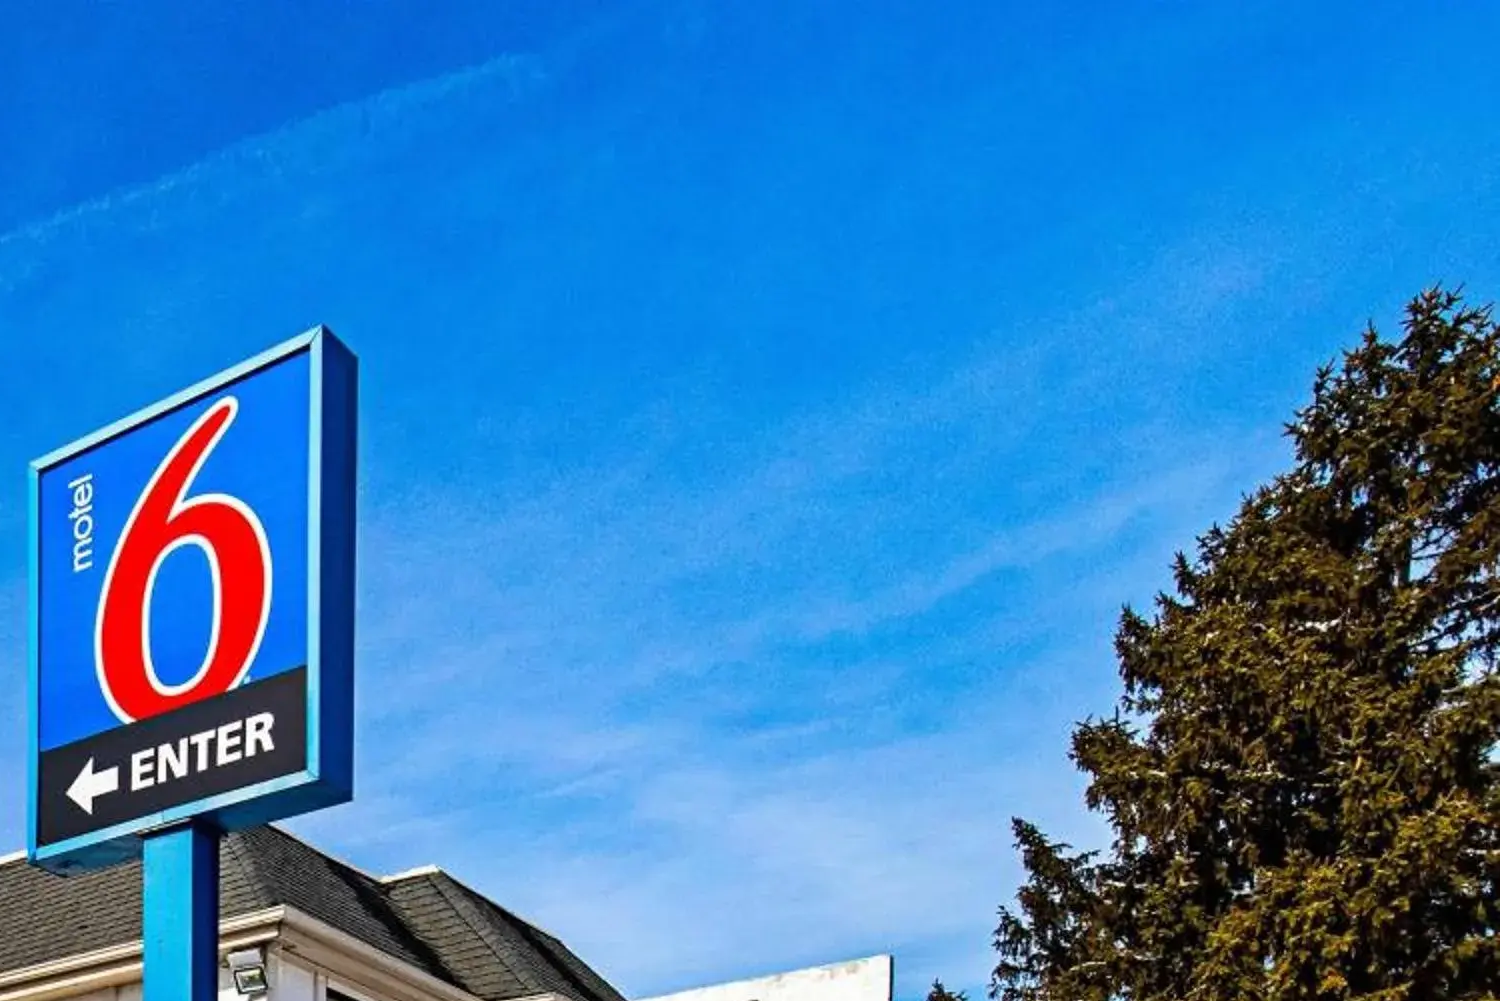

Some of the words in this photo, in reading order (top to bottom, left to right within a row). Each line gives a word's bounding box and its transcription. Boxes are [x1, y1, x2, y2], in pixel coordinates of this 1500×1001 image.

[67, 472, 93, 573] motel
[94, 396, 272, 725] 6
[130, 711, 276, 792] ENTER
